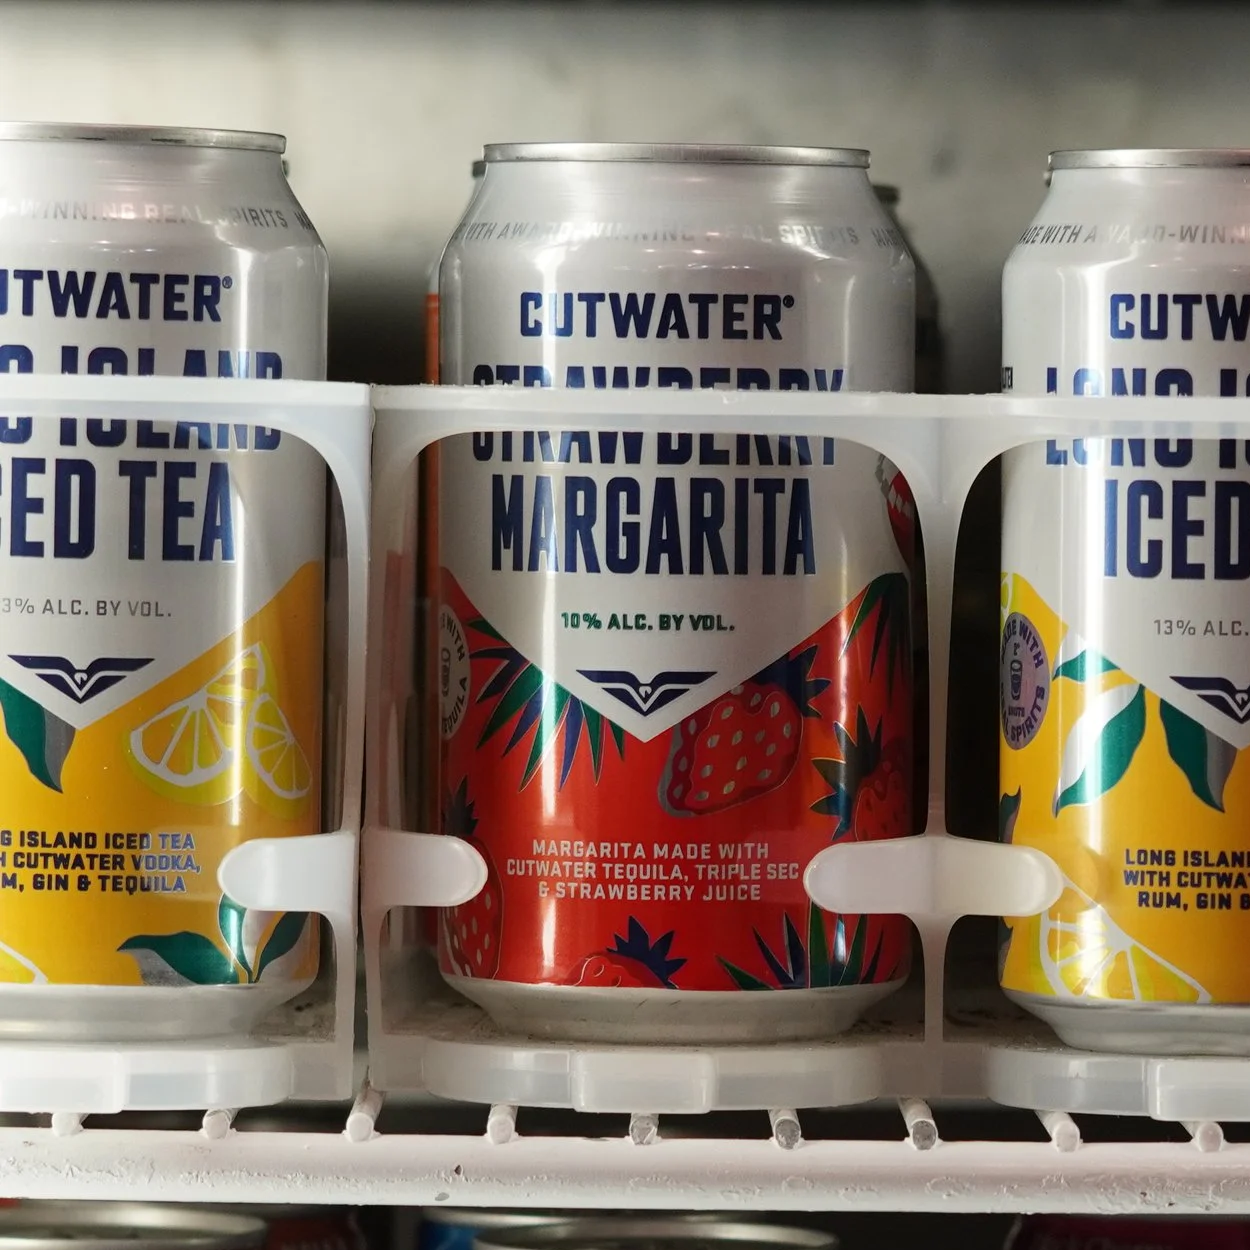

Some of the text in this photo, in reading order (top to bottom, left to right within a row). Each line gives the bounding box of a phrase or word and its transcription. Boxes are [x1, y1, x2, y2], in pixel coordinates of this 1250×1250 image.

[118, 461, 237, 562] TEA
[491, 473, 817, 576] MARGARITA
[561, 612, 735, 632] 10% ALC. BY VOL.
[1153, 619, 1197, 636] 13%
[1203, 620, 1250, 637] ALC.
[19, 830, 195, 850] ISLAND ICED TEA
[532, 840, 769, 860] MARGARITA MADE WITH
[13, 853, 126, 871] CUTWATER
[133, 854, 201, 873] VODKA,
[1125, 848, 1176, 867] LONG
[506, 860, 800, 884] CUTWATER TEQUILA, TRIPLE SEC
[1124, 868, 1171, 888] WITH
[33, 873, 69, 891] GIN
[98, 875, 187, 895] TEQUILA
[538, 881, 762, 901] & STRAWBERRY JUICE
[1138, 891, 1190, 912] RUM,
[1196, 892, 1232, 911] GIN
